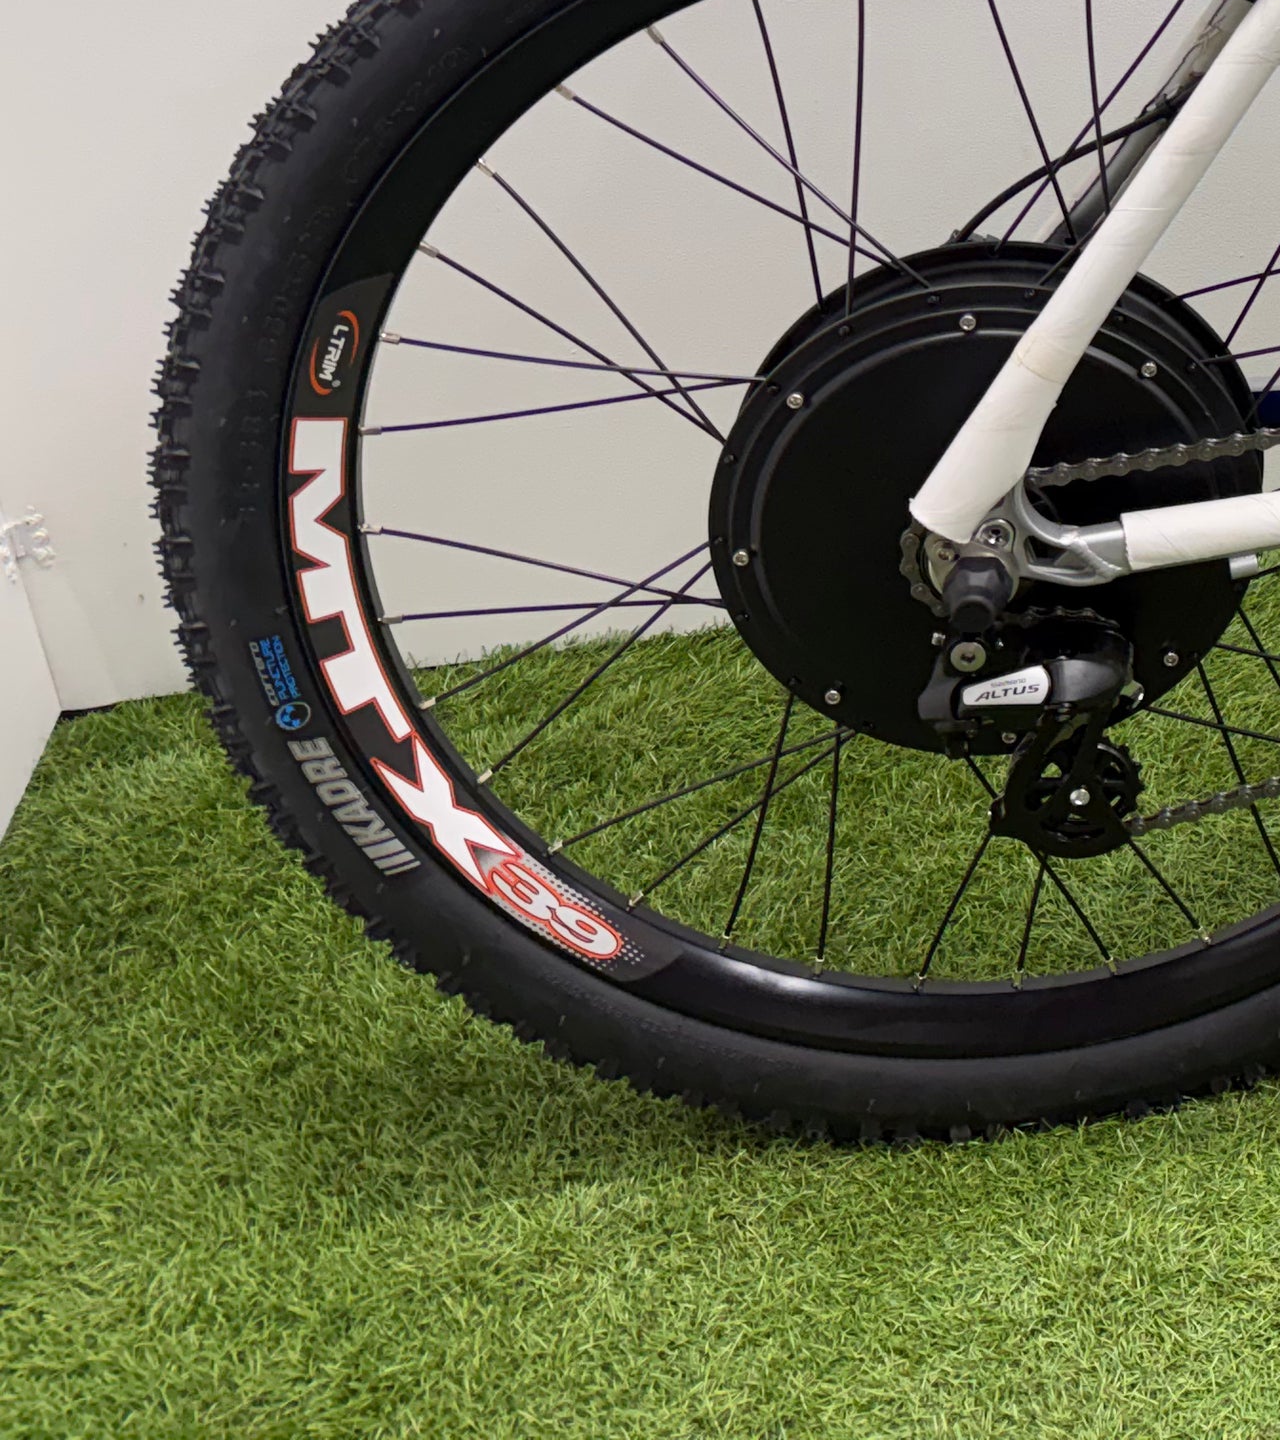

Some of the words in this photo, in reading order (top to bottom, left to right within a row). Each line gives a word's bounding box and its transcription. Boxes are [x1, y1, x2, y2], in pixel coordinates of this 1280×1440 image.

[287, 416, 524, 893] MTX
[485, 850, 624, 961] 39
[974, 684, 1040, 703] ALTUS
[287, 736, 396, 847] KADRE
